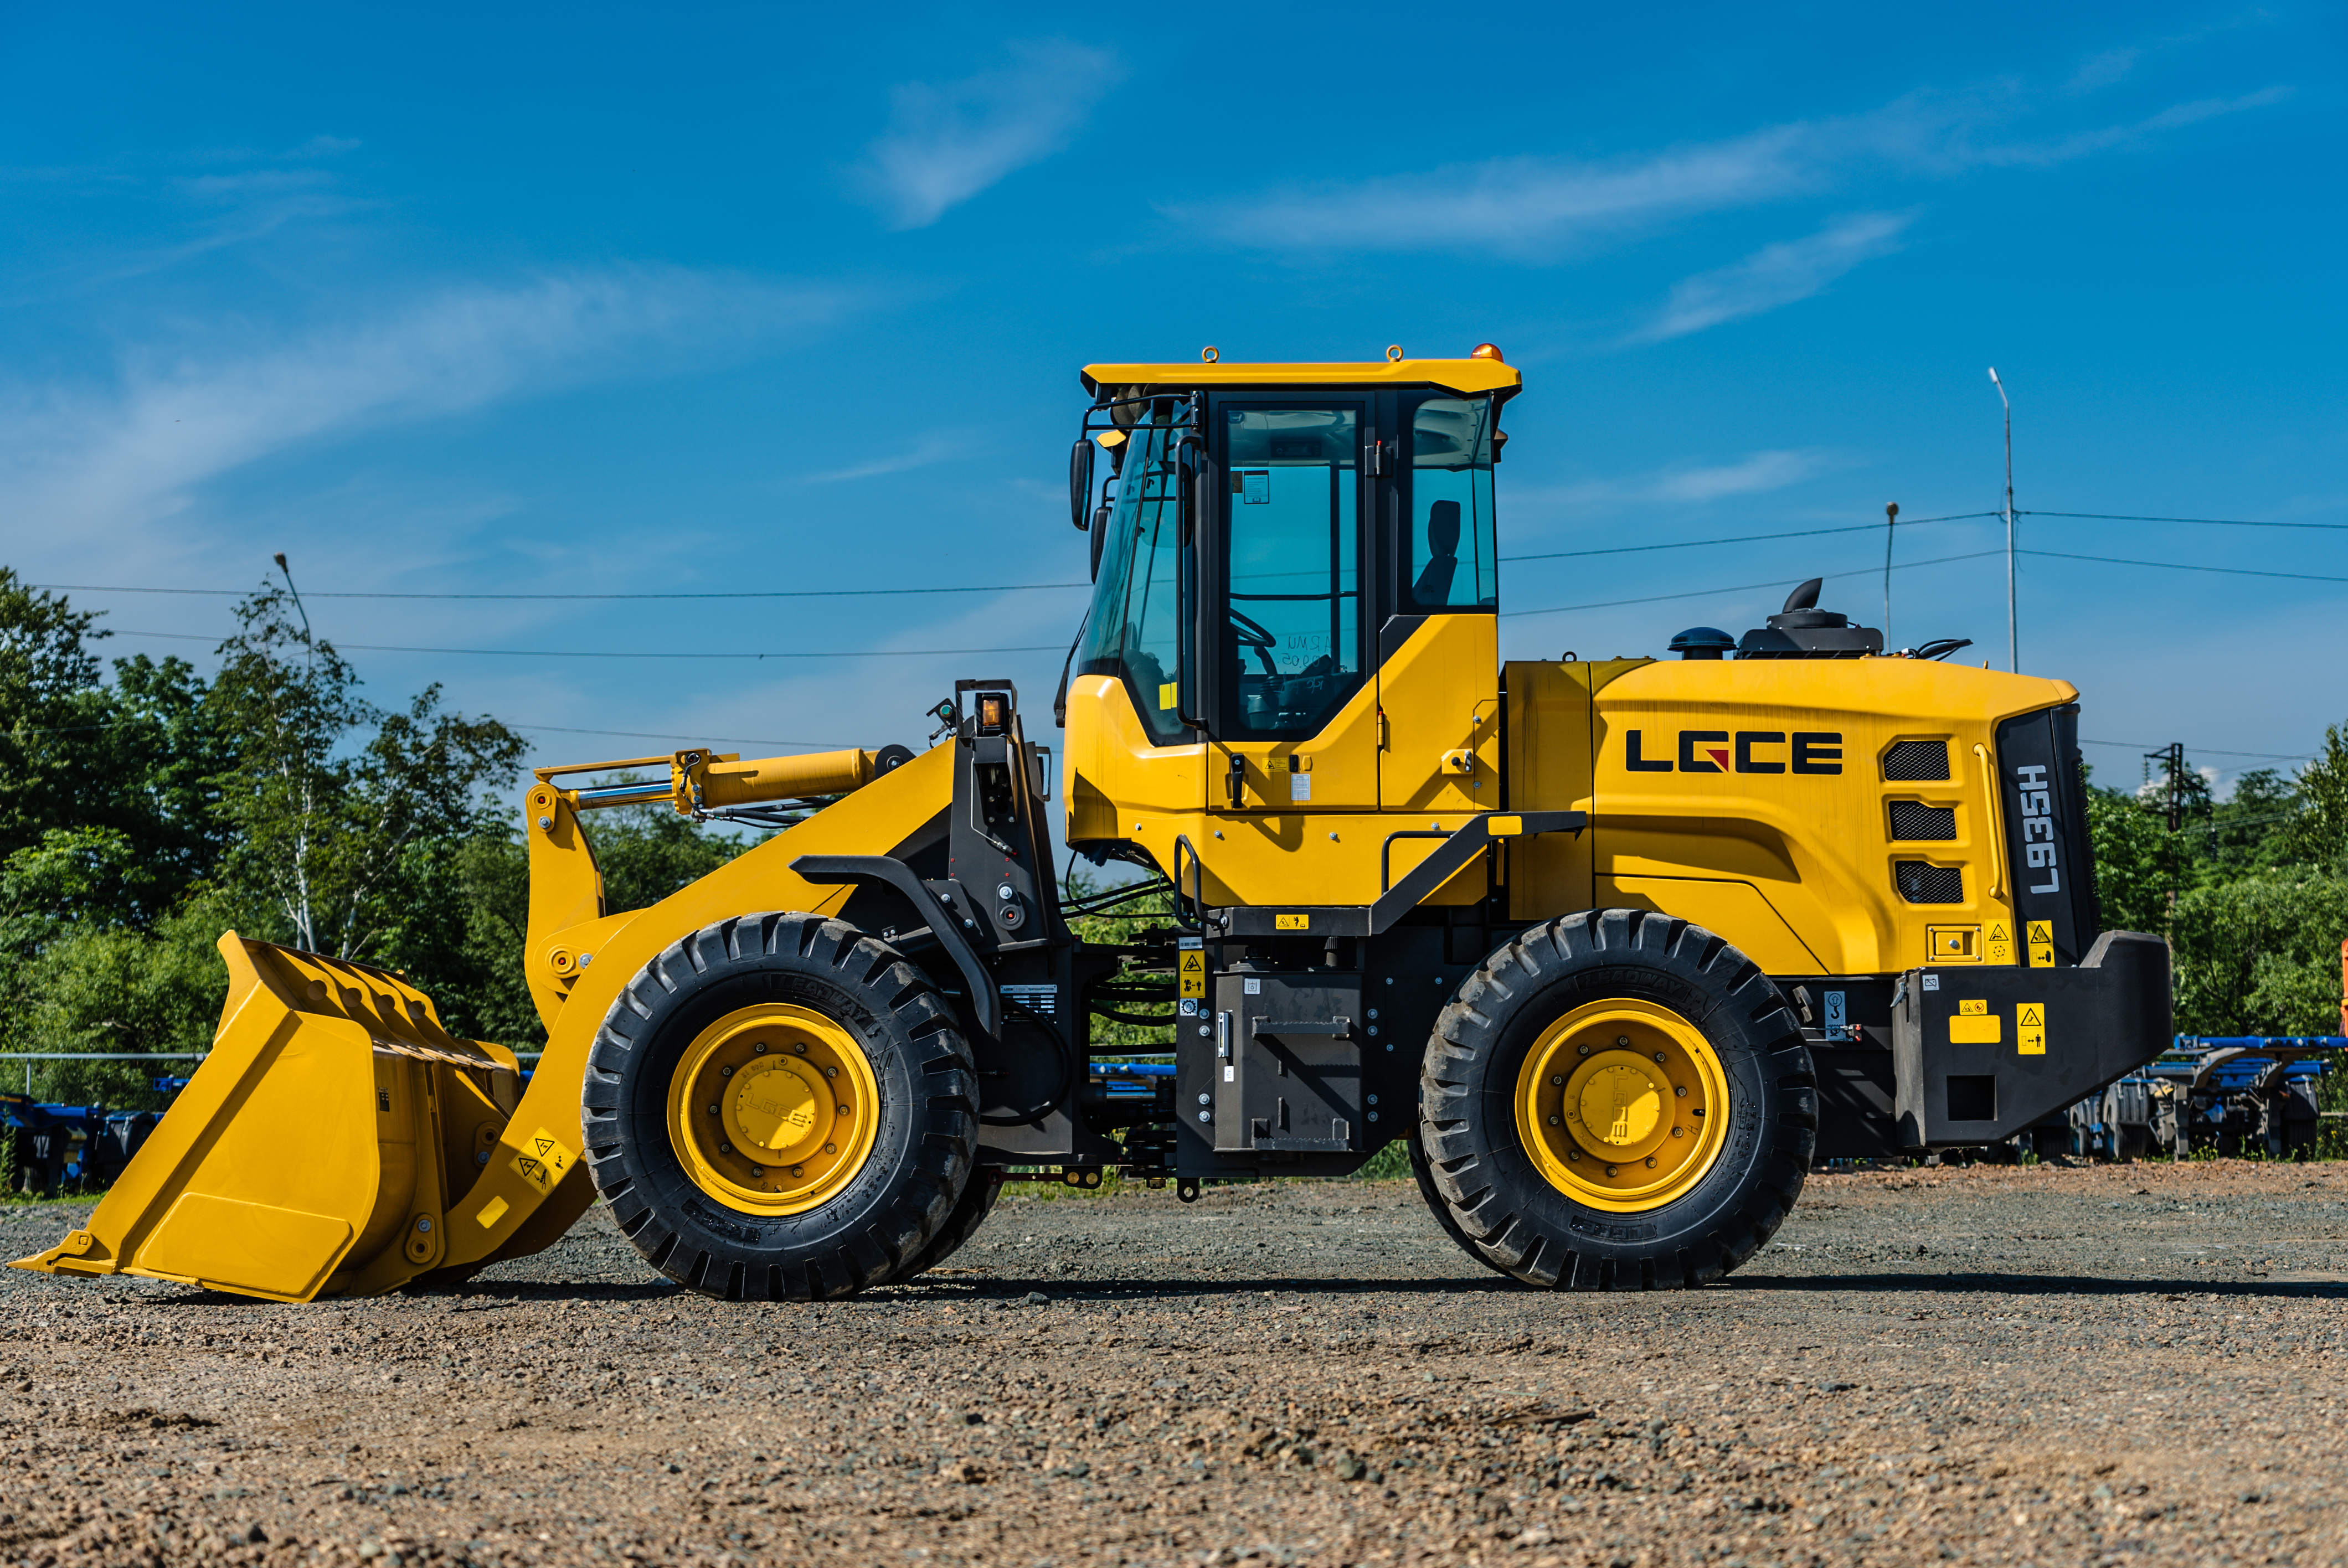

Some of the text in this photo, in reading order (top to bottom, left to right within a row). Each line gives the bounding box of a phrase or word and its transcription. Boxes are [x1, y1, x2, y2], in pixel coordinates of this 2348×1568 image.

[1626, 729, 1842, 775] LGCE
[2017, 765, 2060, 894] L935H
[745, 1093, 808, 1128] LGCE
[1612, 1074, 1629, 1138] LGCE
